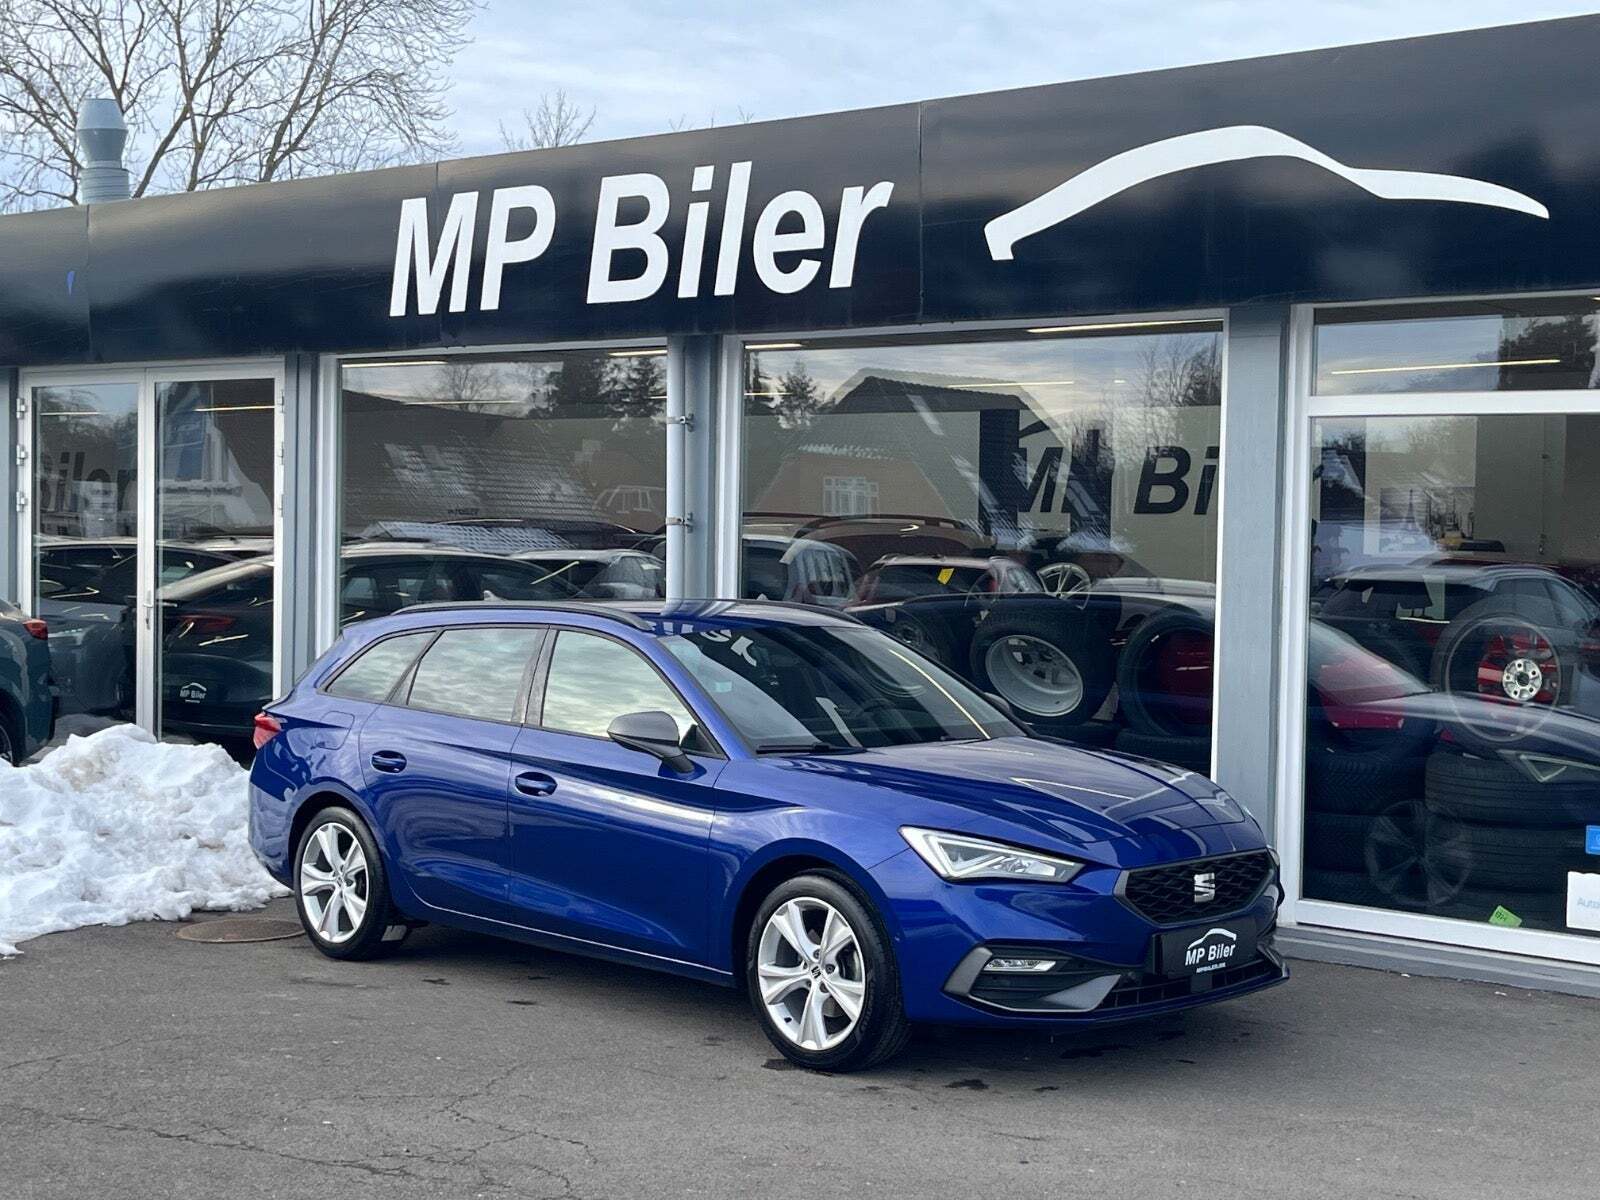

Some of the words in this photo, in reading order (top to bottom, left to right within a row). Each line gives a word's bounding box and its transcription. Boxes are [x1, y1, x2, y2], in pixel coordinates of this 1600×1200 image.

[389, 184, 557, 318] MP
[586, 160, 895, 304] Biler
[1185, 948, 1206, 966] MP
[1207, 943, 1236, 961] Biler
